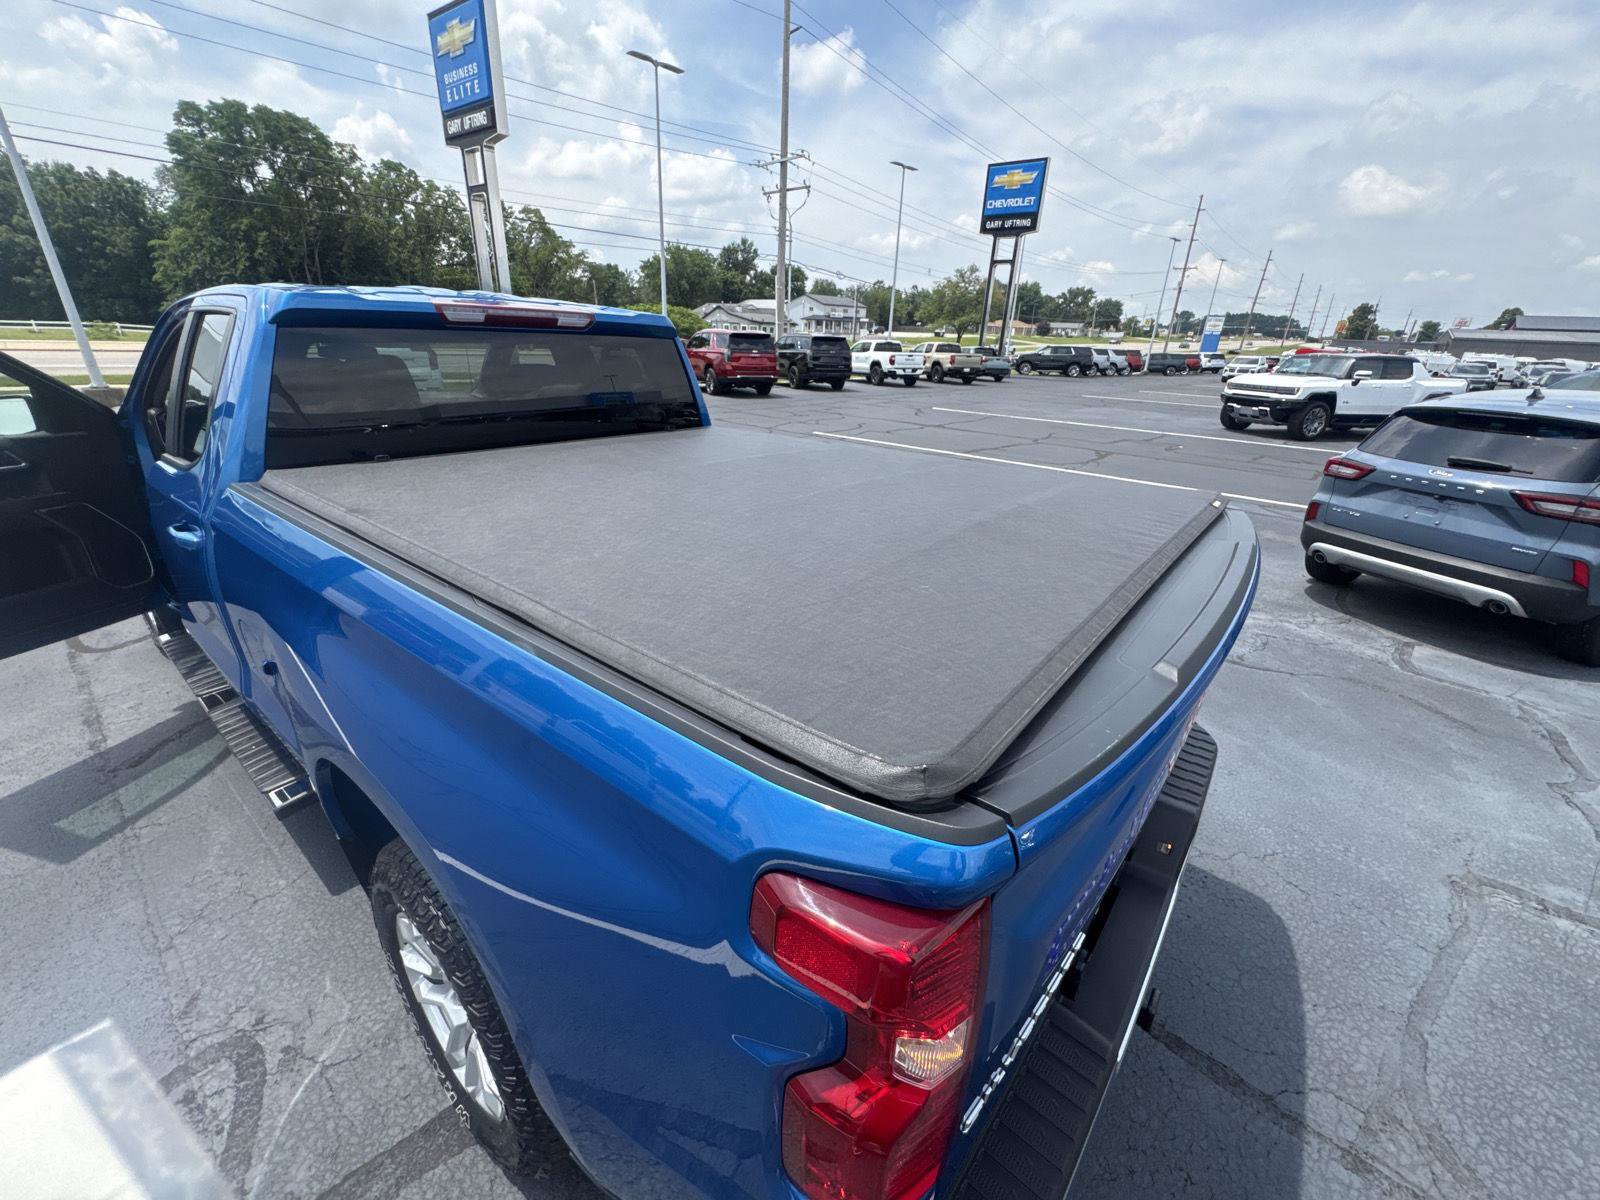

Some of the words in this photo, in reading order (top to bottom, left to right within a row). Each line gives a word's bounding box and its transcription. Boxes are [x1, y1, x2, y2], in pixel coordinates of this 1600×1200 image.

[444, 62, 478, 85] BUSINESS
[446, 80, 480, 103] ELITE
[447, 118, 462, 135] GARY
[463, 110, 488, 131] UFTRING
[987, 196, 1036, 209] CHEVROLET
[986, 220, 1002, 229] GARY
[1005, 218, 1031, 228] UFTRING
